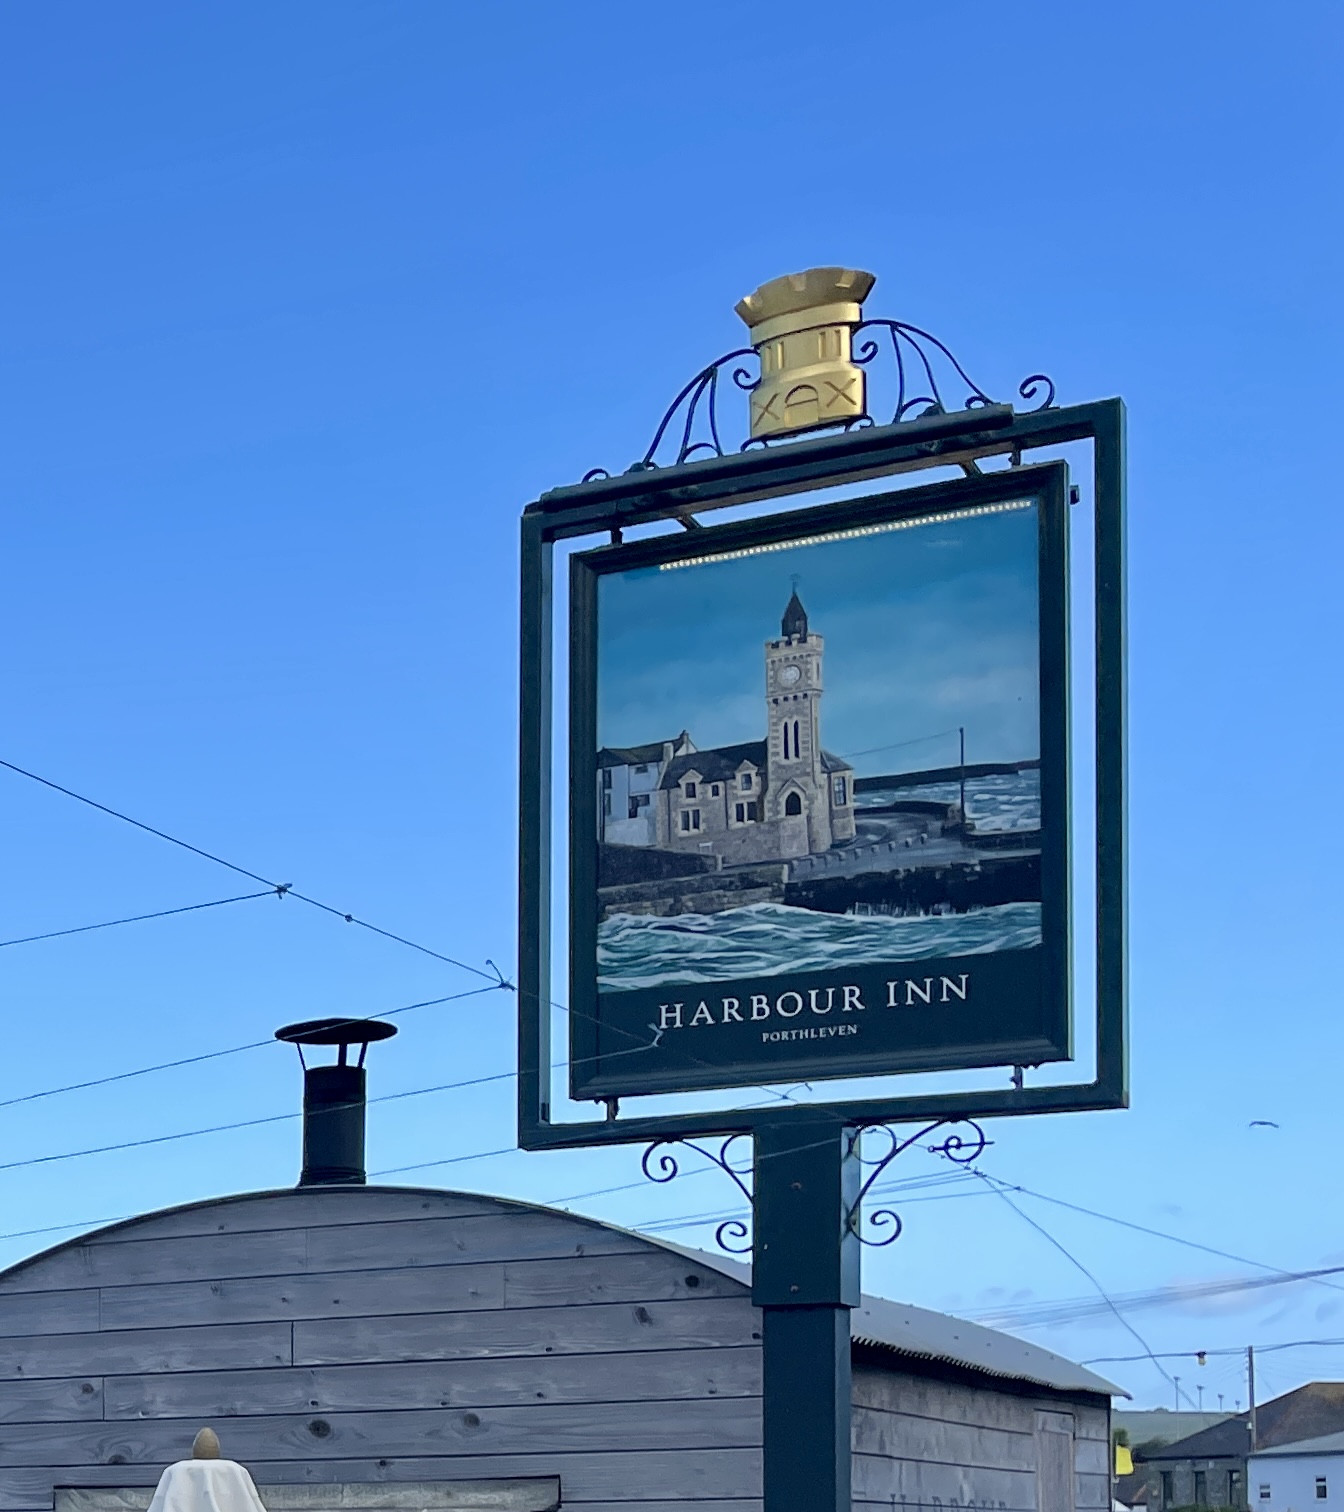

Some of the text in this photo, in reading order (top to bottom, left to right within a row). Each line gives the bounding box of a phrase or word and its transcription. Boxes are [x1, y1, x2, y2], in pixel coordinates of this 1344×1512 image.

[659, 974, 970, 1029] HARBOUR INN
[762, 1024, 858, 1043] PORTHLEVEN
